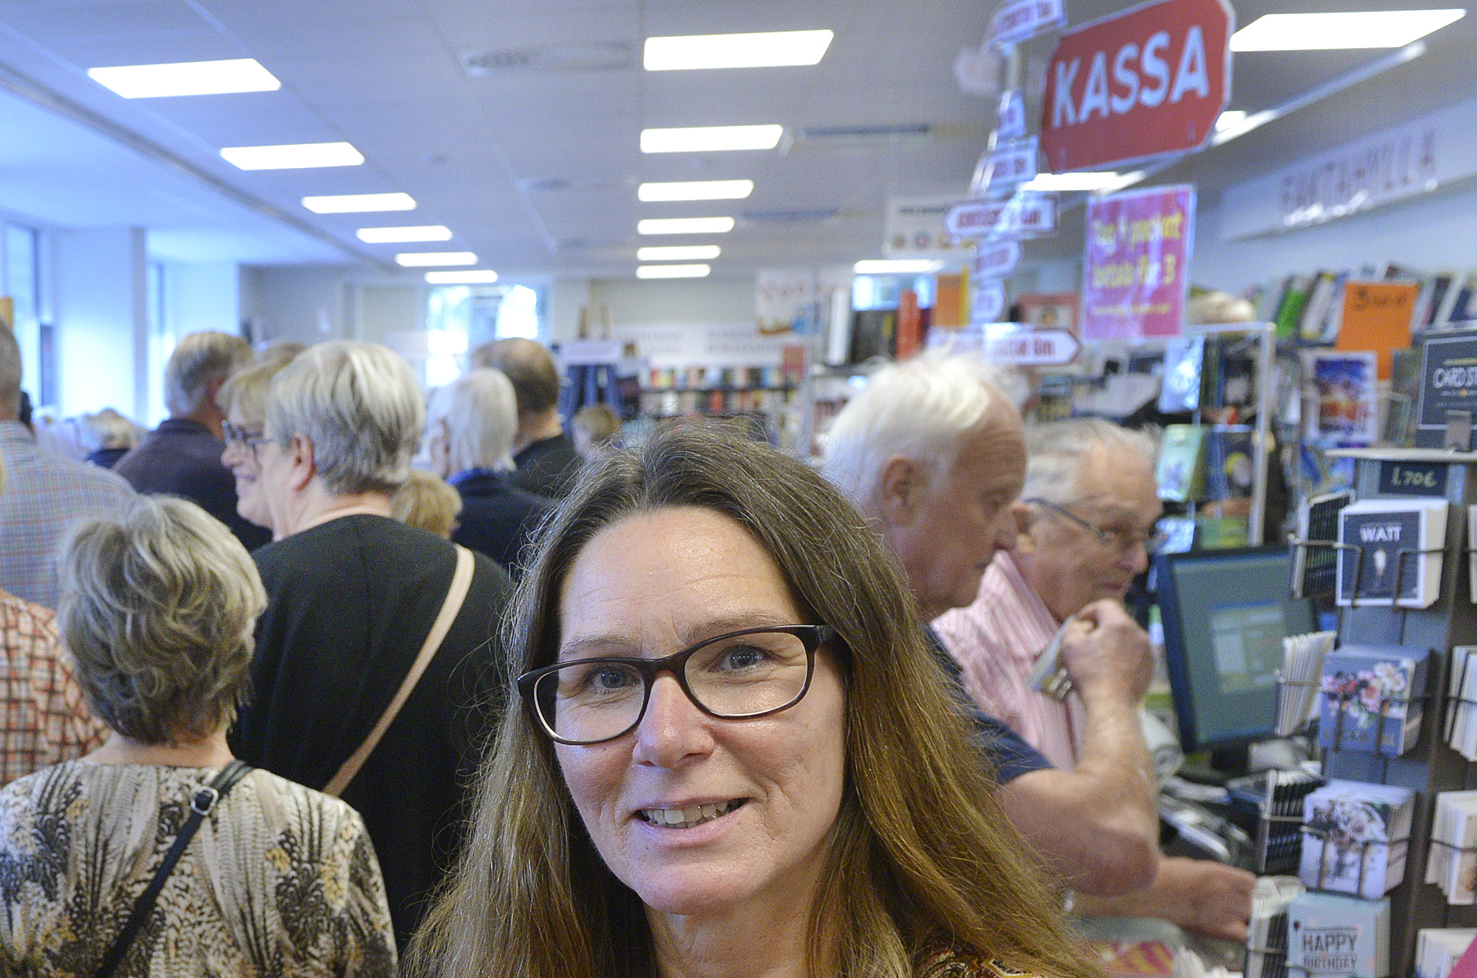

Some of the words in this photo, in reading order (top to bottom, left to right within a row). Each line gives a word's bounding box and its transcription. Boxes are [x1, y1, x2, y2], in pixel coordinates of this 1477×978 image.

[1051, 25, 1210, 129] KASSA
[1360, 526, 1403, 542] WATT
[1302, 933, 1358, 952] HAPPY
[1303, 956, 1358, 971] BIRTHDAY
